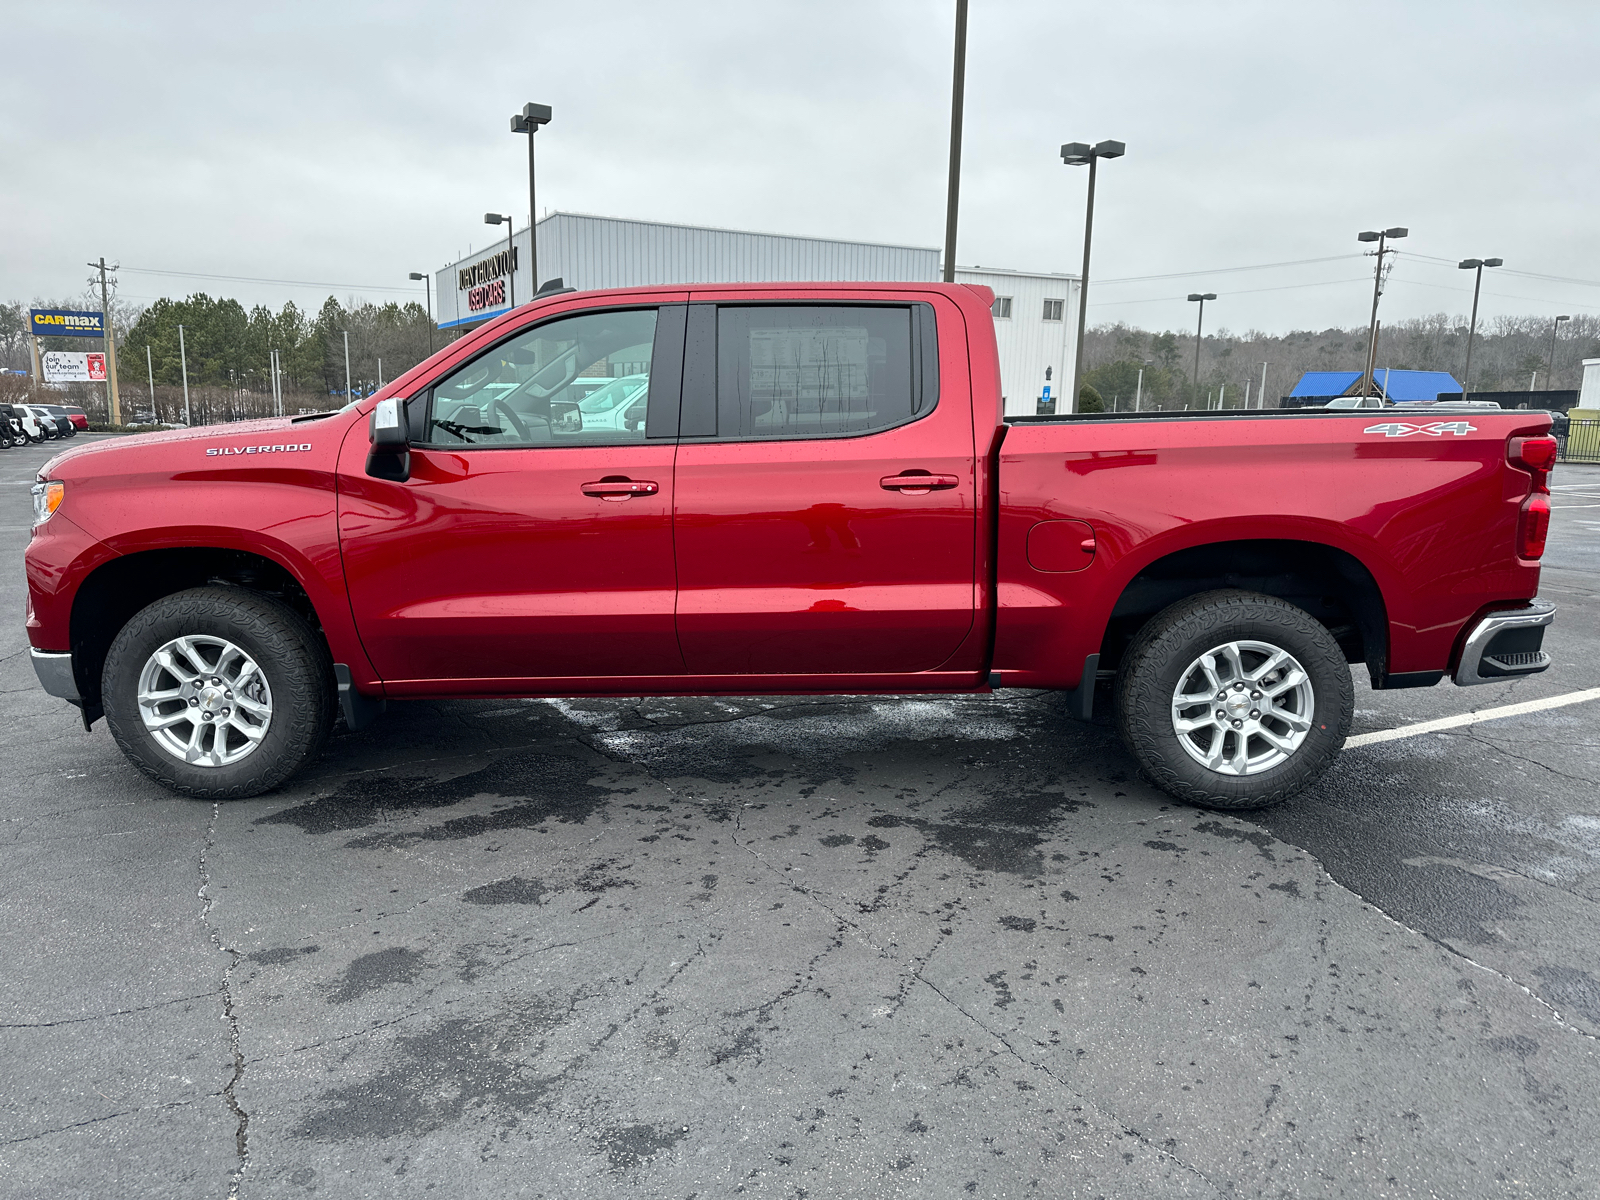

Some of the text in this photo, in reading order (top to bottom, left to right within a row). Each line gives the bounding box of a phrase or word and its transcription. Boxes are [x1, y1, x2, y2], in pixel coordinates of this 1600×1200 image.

[468, 280, 505, 311] USED CARS
[206, 443, 312, 456] SILVERADO
